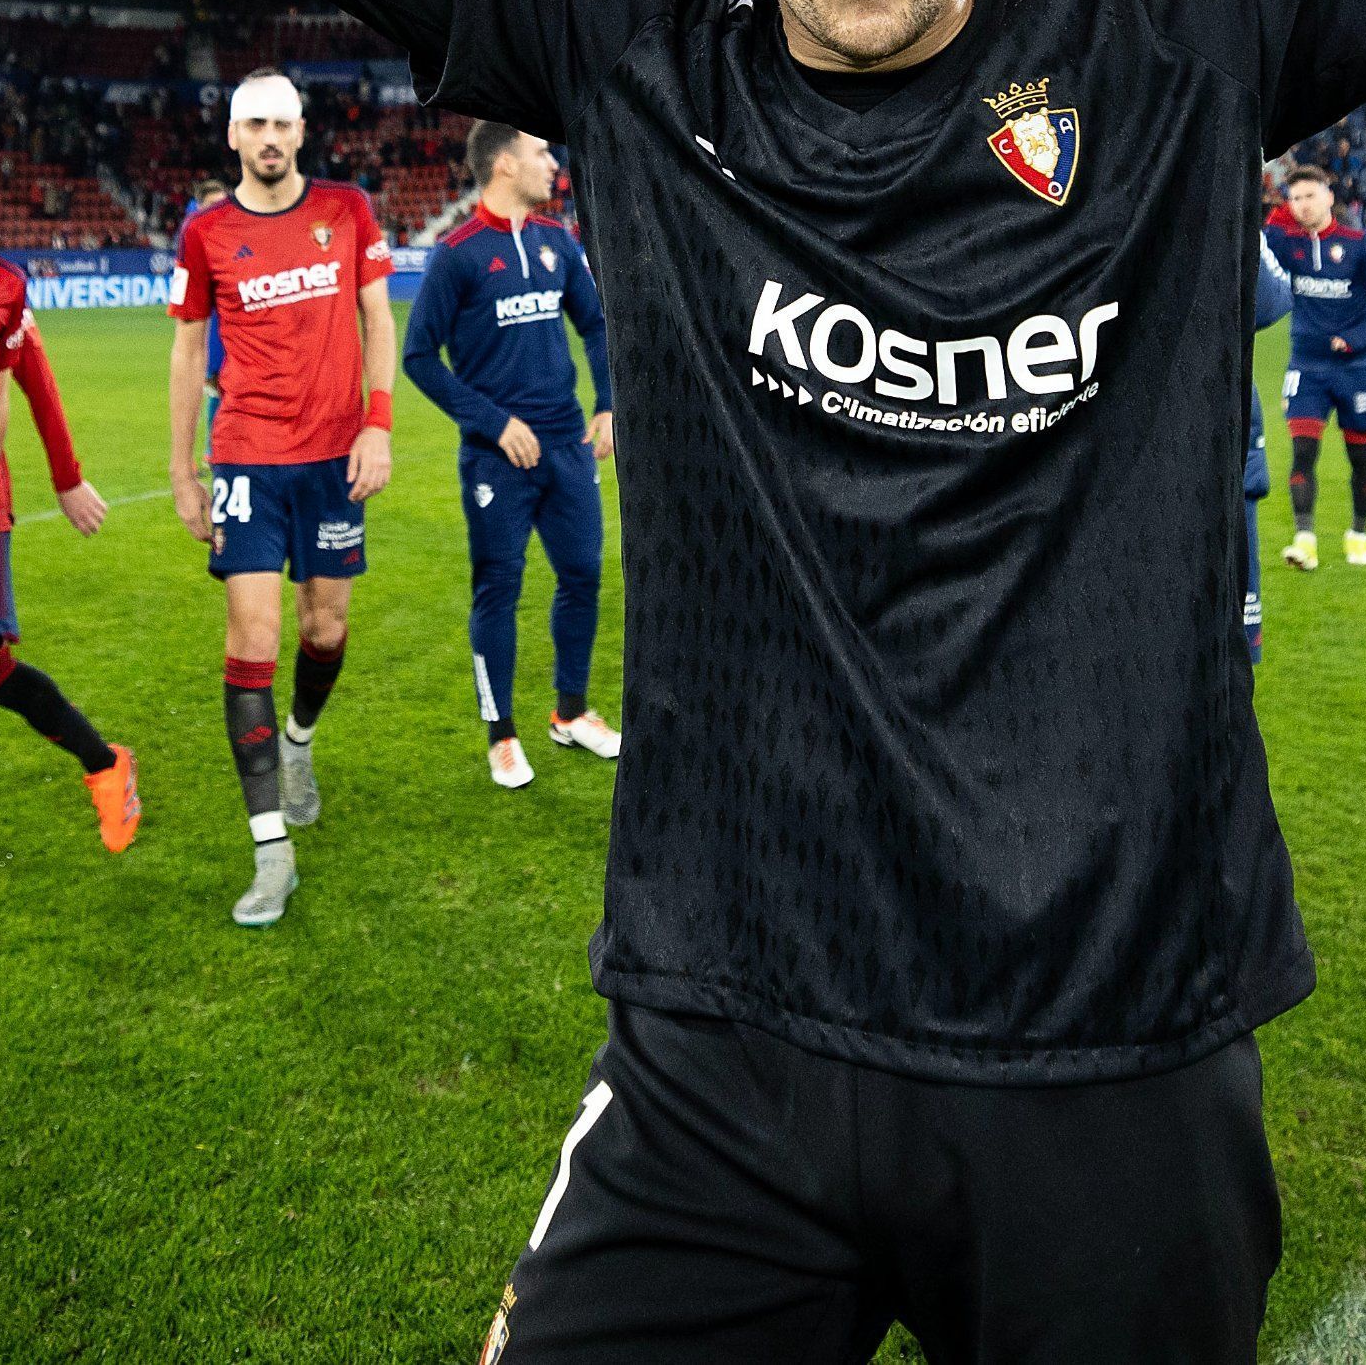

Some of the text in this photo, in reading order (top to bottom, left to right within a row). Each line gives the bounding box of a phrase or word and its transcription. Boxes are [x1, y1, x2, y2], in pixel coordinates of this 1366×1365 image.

[26, 274, 175, 311] NIVERSIDA
[821, 380, 1100, 434] Climatización eficiente
[211, 475, 252, 523] 24
[528, 1080, 614, 1253] 1
